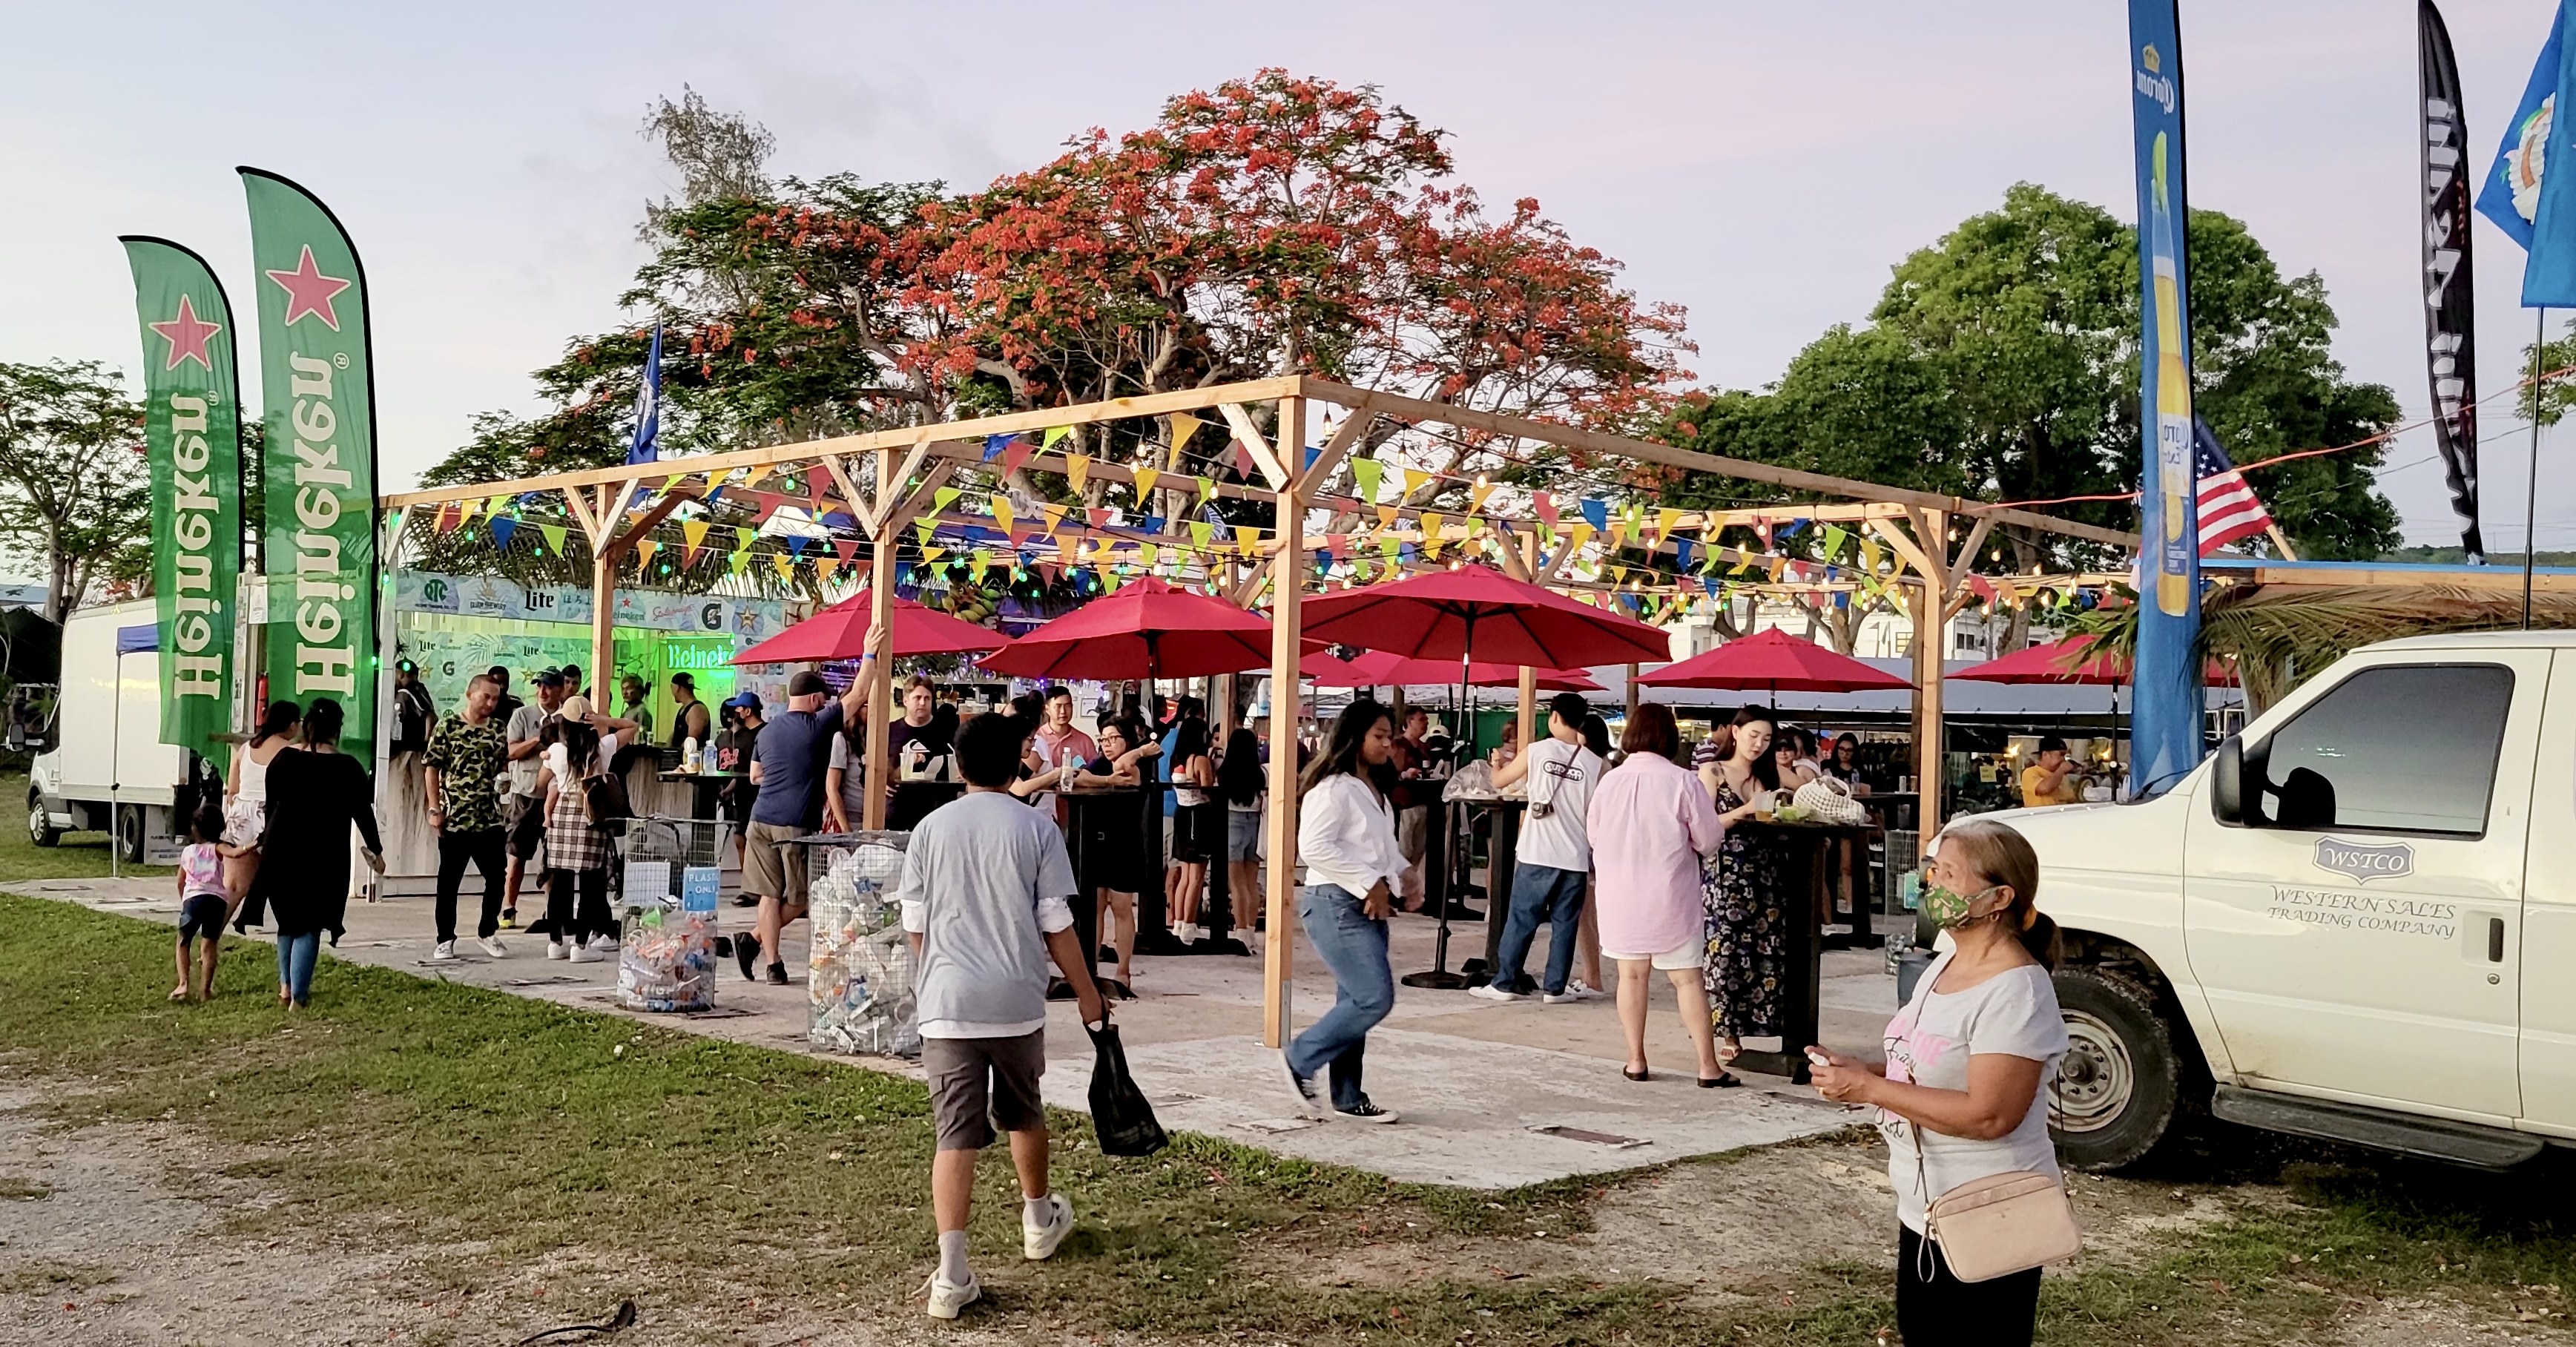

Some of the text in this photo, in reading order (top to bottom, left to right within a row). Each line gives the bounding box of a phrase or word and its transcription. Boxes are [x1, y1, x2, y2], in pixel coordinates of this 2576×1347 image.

[524, 590, 555, 611] Lite
[563, 594, 592, 606] ほろよ
[613, 607, 645, 621] eineken
[702, 603, 722, 630] G
[419, 639, 436, 653] Lite
[523, 645, 539, 657] Lite
[1544, 761, 1584, 781] OUTDOR
[2325, 847, 2405, 872] WSTCO
[2270, 885, 2457, 920] WESTERN SALES
[2267, 906, 2455, 940] TRADING COMPANY
